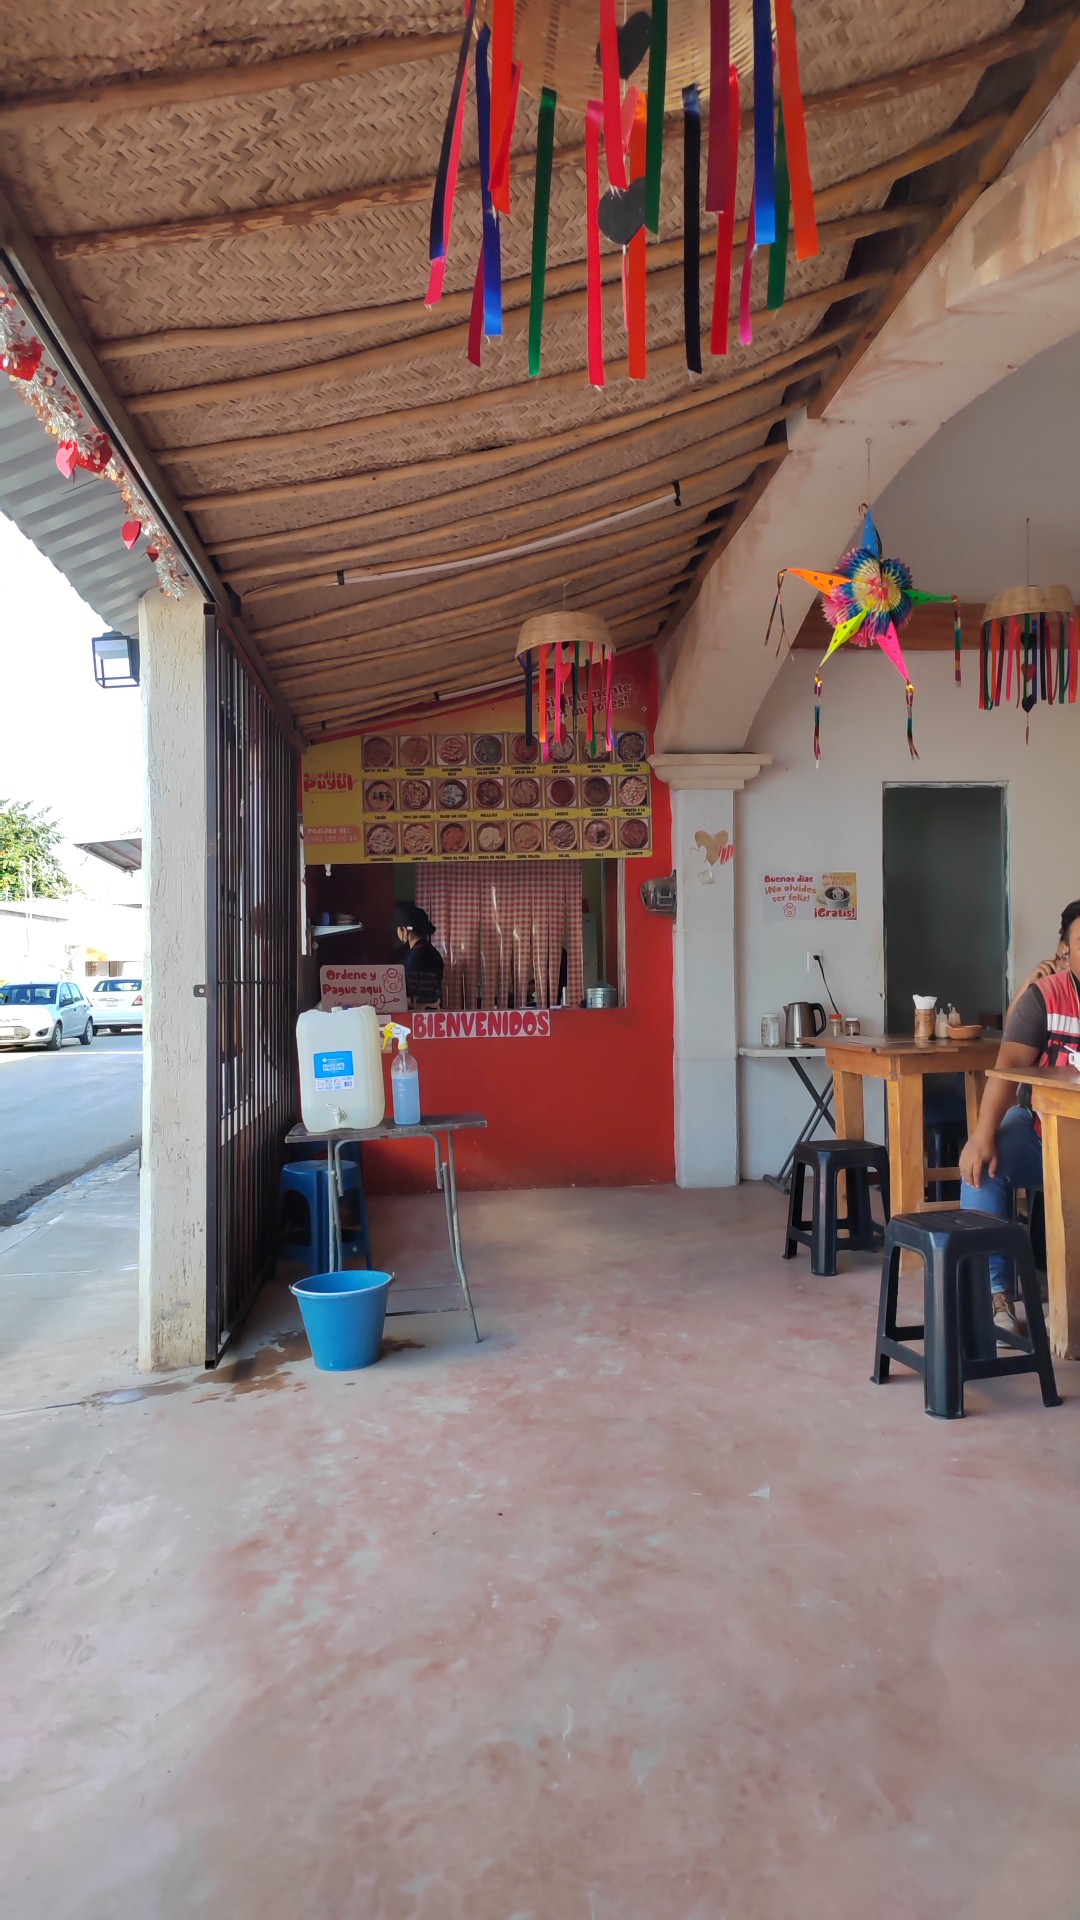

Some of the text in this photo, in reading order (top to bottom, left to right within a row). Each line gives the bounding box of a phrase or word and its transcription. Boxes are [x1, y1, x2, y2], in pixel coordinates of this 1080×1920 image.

[303, 770, 347, 780] grditas
[764, 875, 795, 883] Buenos
[764, 884, 817, 895] ¡No olvides
[788, 893, 810, 903] feliz!
[814, 907, 855, 918] ¡Gratis!
[326, 969, 377, 981] Ordene y
[322, 983, 357, 996] Pague
[413, 1011, 549, 1039] BIENVENIDOS
